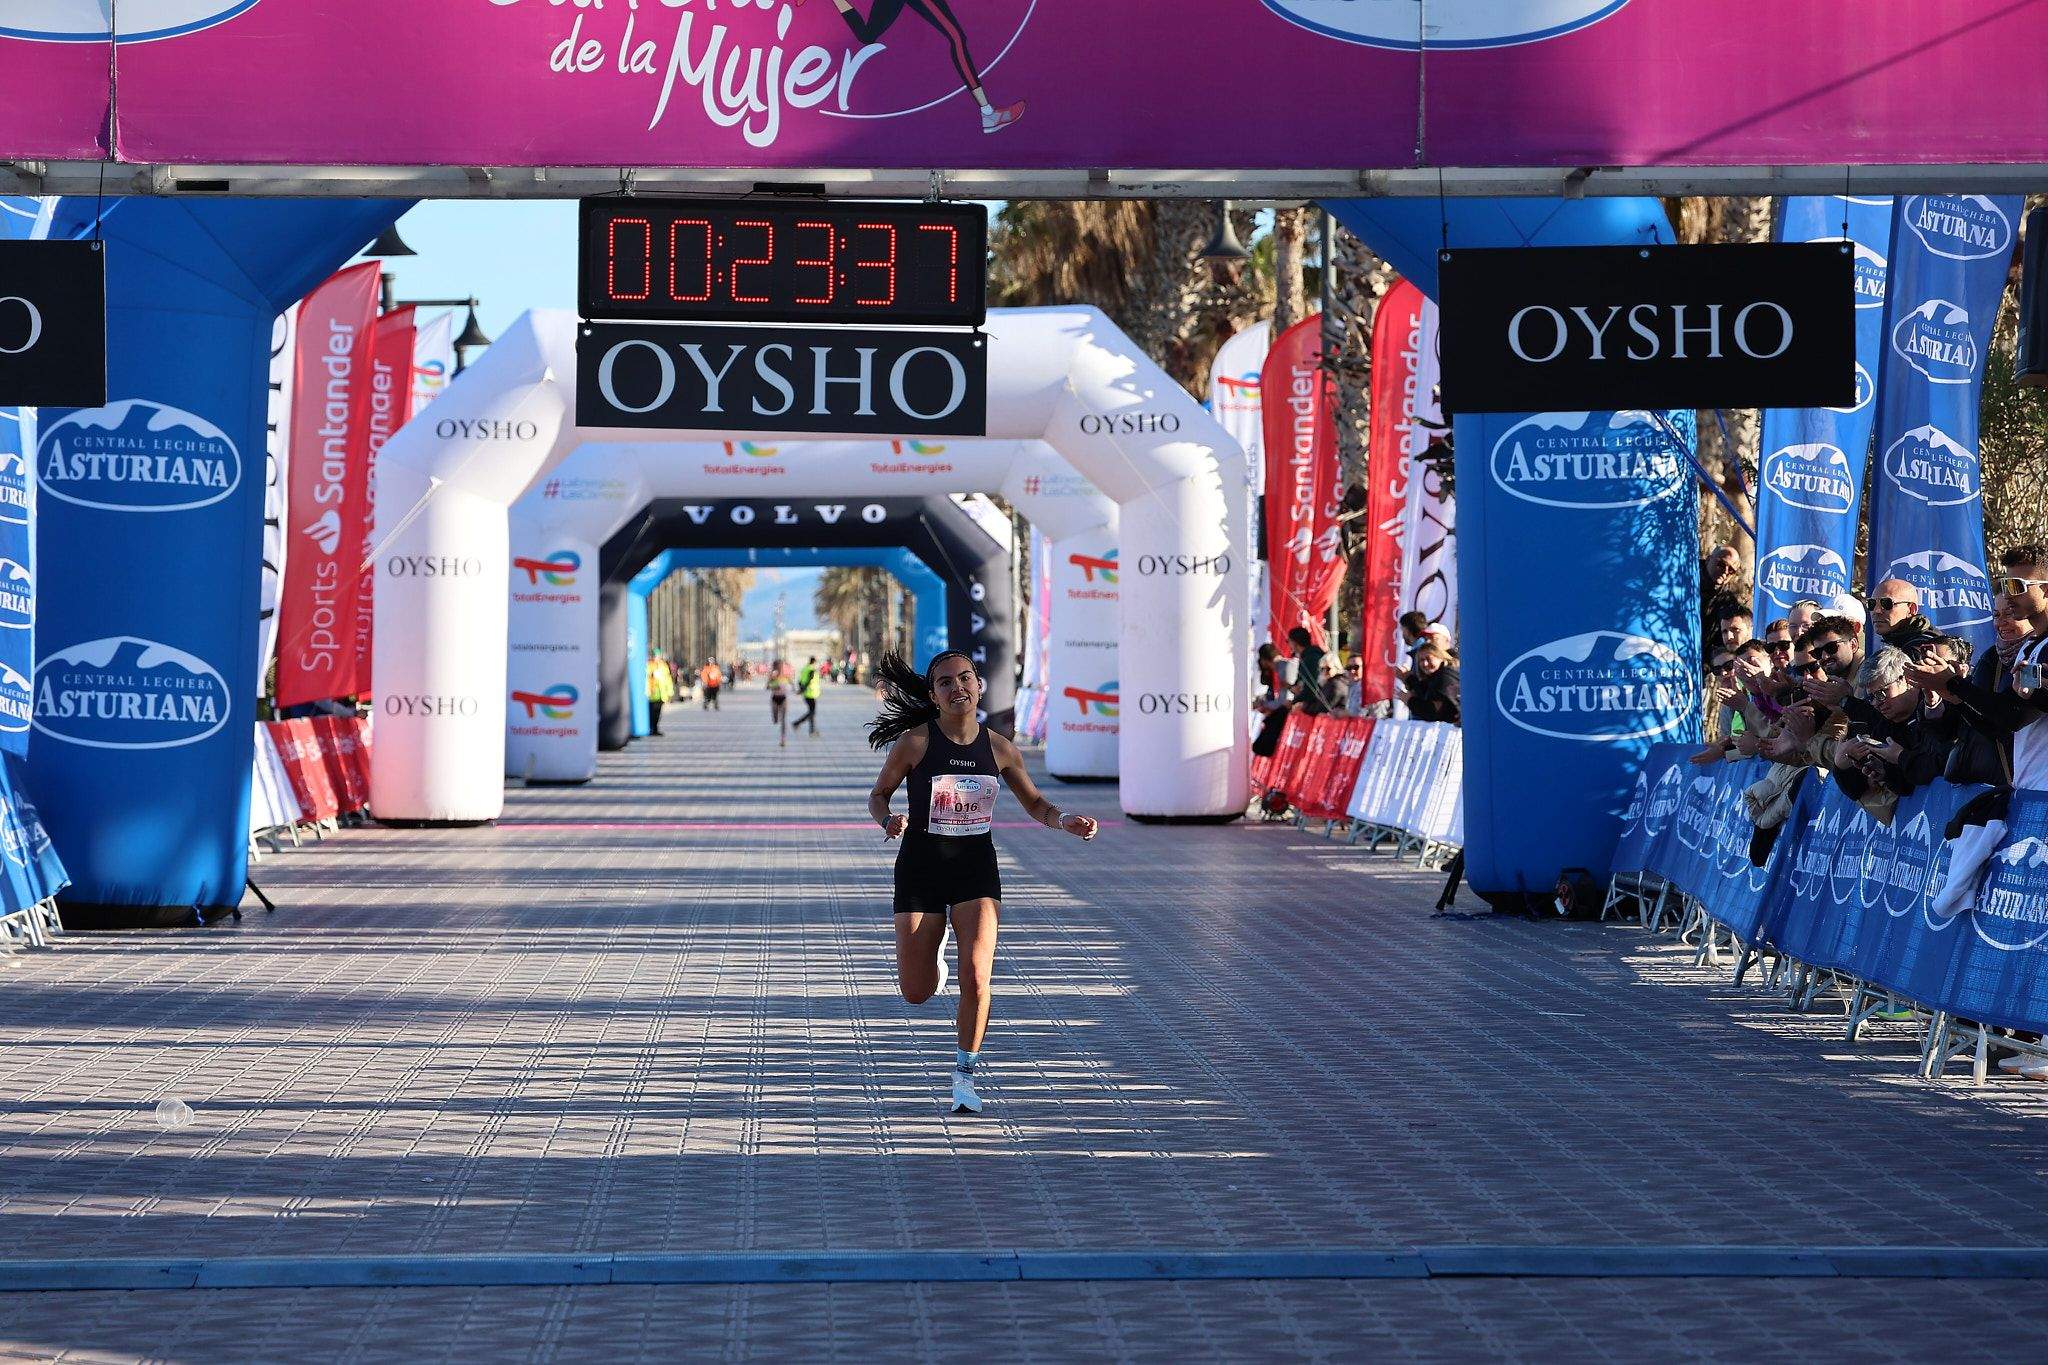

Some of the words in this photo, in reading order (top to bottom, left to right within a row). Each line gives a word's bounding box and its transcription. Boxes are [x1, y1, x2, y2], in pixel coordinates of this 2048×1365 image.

[549, 14, 605, 73] de
[618, 14, 657, 74] la
[648, 3, 887, 148] Mujer
[608, 218, 957, 306] 00:23:37
[1508, 301, 1794, 362] OYSHO
[598, 339, 966, 420] OYSHO
[319, 317, 354, 504] Santander
[436, 419, 537, 440] OYSHO
[1080, 412, 1180, 435] OYSHO
[73, 437, 146, 448] CENTRAL
[154, 438, 223, 454] LECHERA
[1286, 365, 1313, 522] Santander
[1536, 437, 1609, 448] CENTRAL
[43, 438, 228, 487] ASTURIANA
[1505, 441, 1679, 482] ASTURIANA
[1786, 461, 1829, 474] CENTRAL
[683, 504, 887, 524] VOLVO
[388, 556, 482, 577] OYSHO
[1138, 555, 1231, 576] OYSHO
[1777, 563, 1817, 576] CENTRAL
[301, 561, 340, 671] Sports
[63, 674, 135, 686] CENTRAL
[144, 677, 213, 690] LECHERA
[1542, 669, 1614, 679] CENTRAL
[33, 676, 218, 723] ASTURIANA
[1510, 672, 1683, 713] ASTURIANA
[385, 695, 478, 716] OYSHO
[1139, 693, 1231, 715] OYSHO
[950, 759, 976, 768] OYSHO
[954, 803, 978, 813] 016
